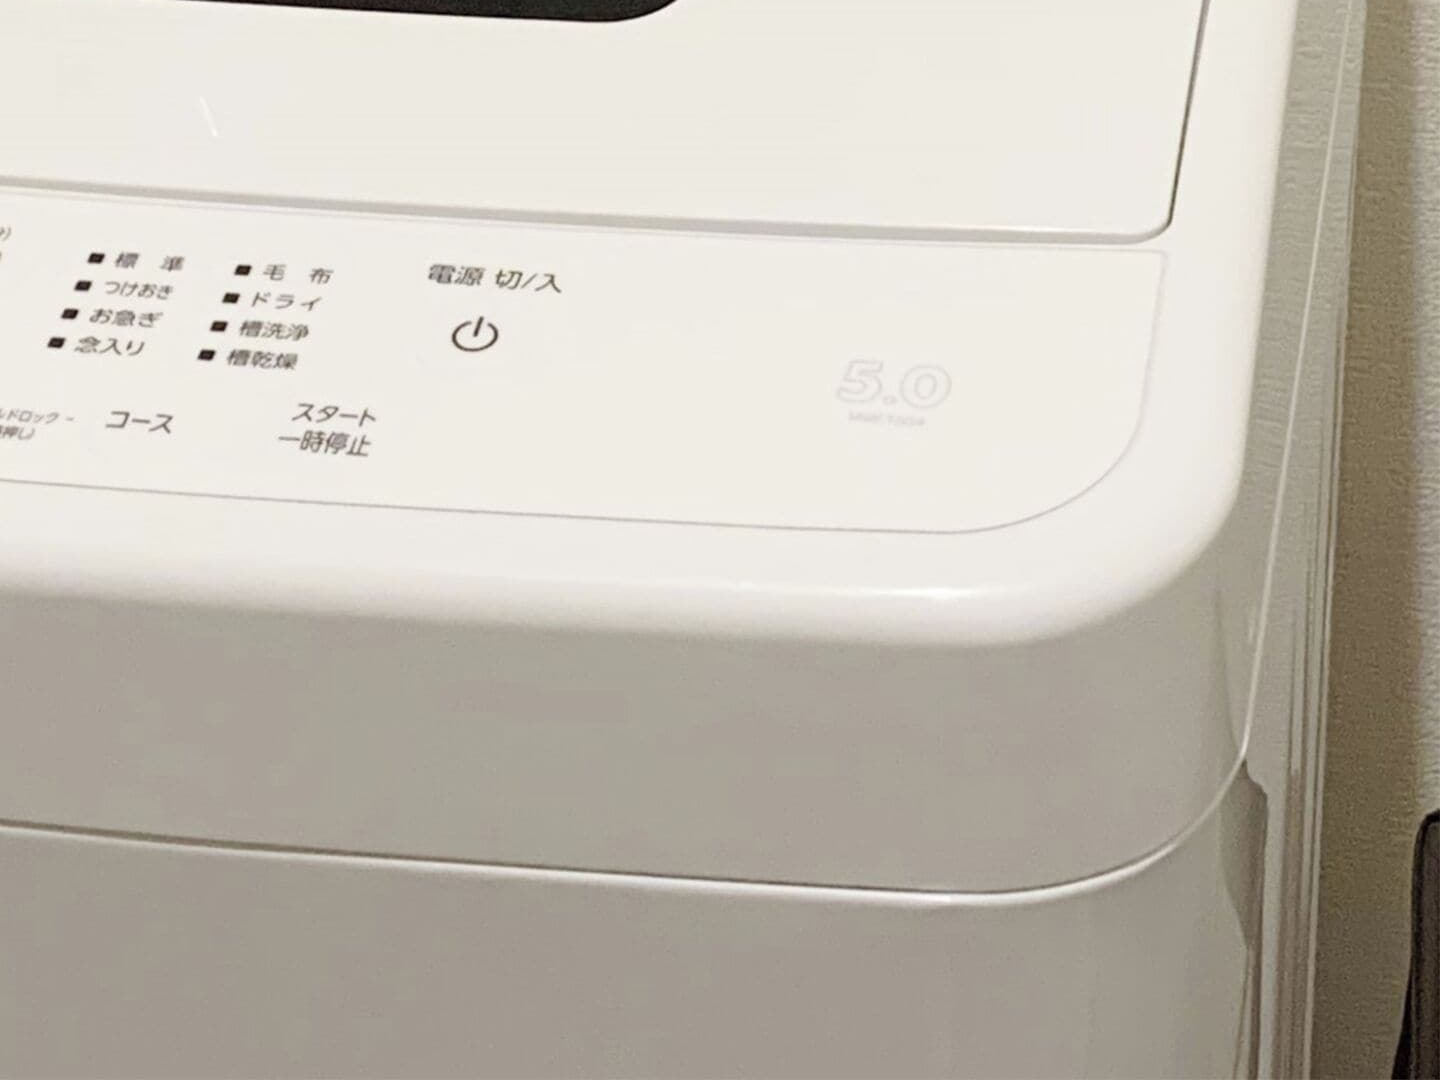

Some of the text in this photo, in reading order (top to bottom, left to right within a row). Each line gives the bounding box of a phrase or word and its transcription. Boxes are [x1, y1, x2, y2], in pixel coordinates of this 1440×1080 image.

[428, 264, 485, 286] 電源
[105, 281, 173, 300] つけおき
[89, 308, 163, 328] お急ぎ
[74, 336, 145, 356] 念入り
[836, 359, 952, 408] 5.0
[105, 411, 174, 434] コース
[291, 403, 376, 427] スタート
[278, 430, 371, 457] 一時停止
